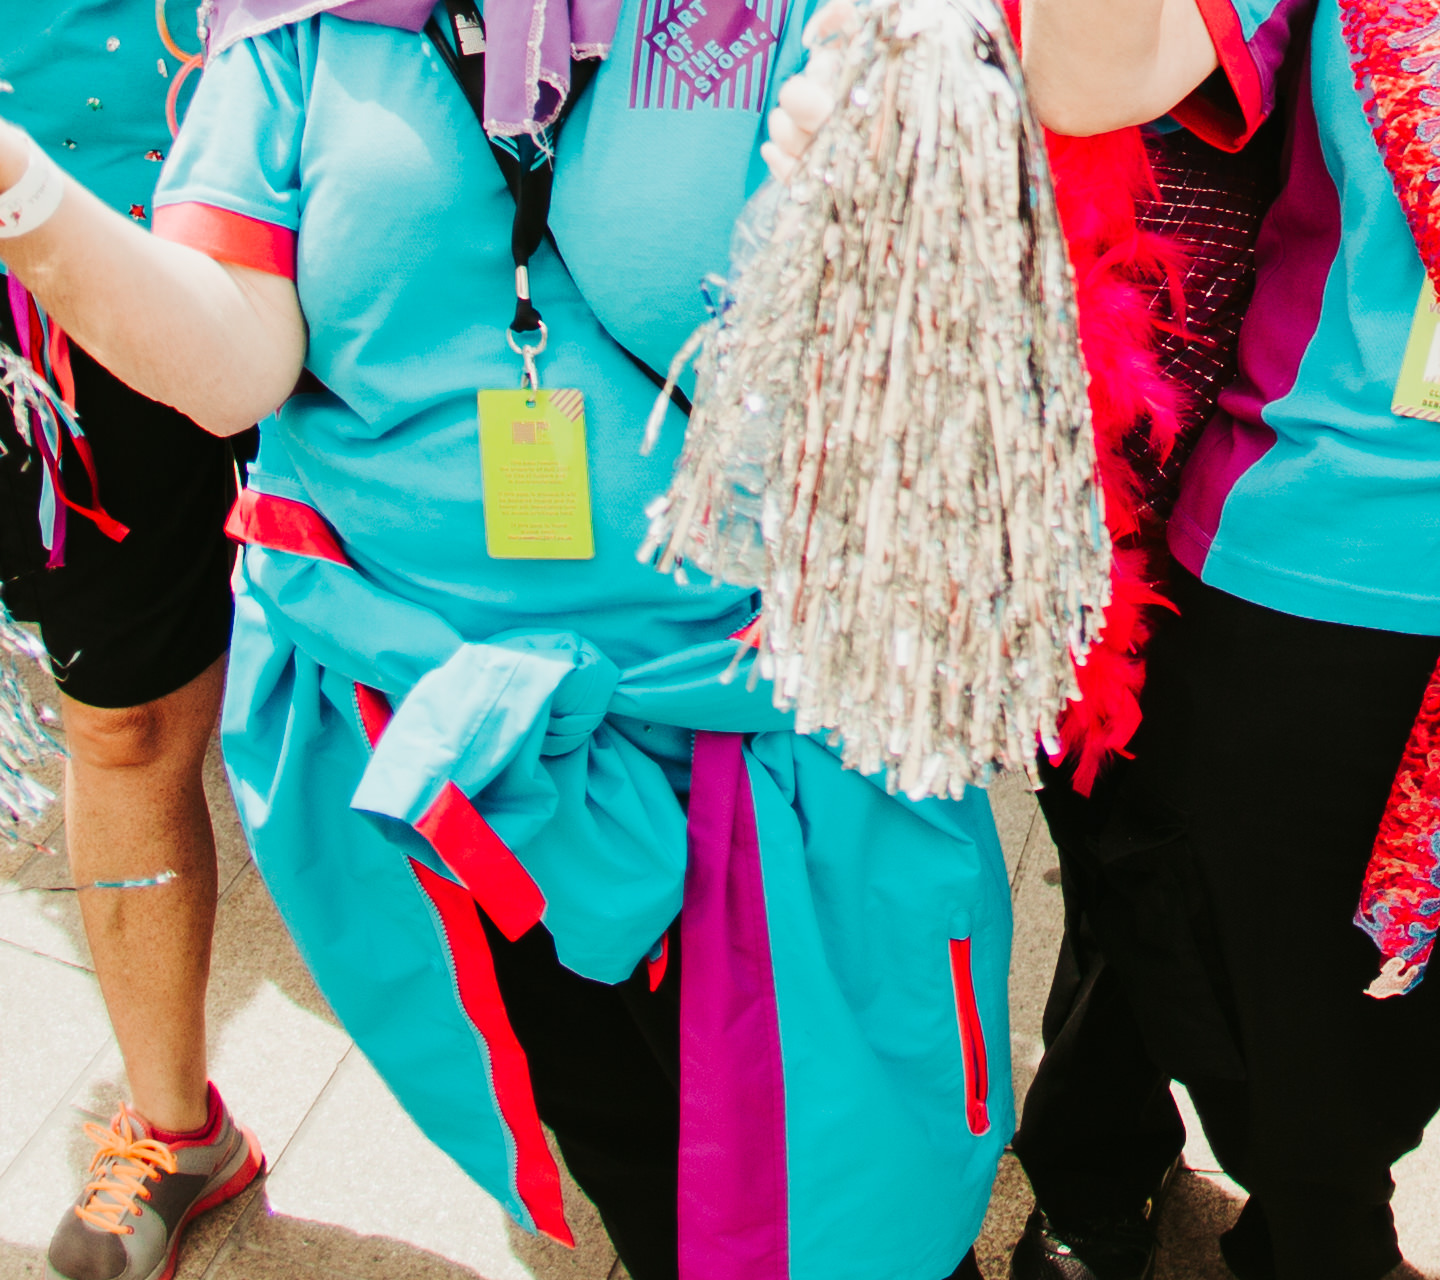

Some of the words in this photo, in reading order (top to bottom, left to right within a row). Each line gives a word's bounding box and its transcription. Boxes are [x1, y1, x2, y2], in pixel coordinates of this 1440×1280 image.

[666, 34, 695, 63] OF
[678, 40, 725, 80] THE
[694, 27, 768, 94] STORY.
